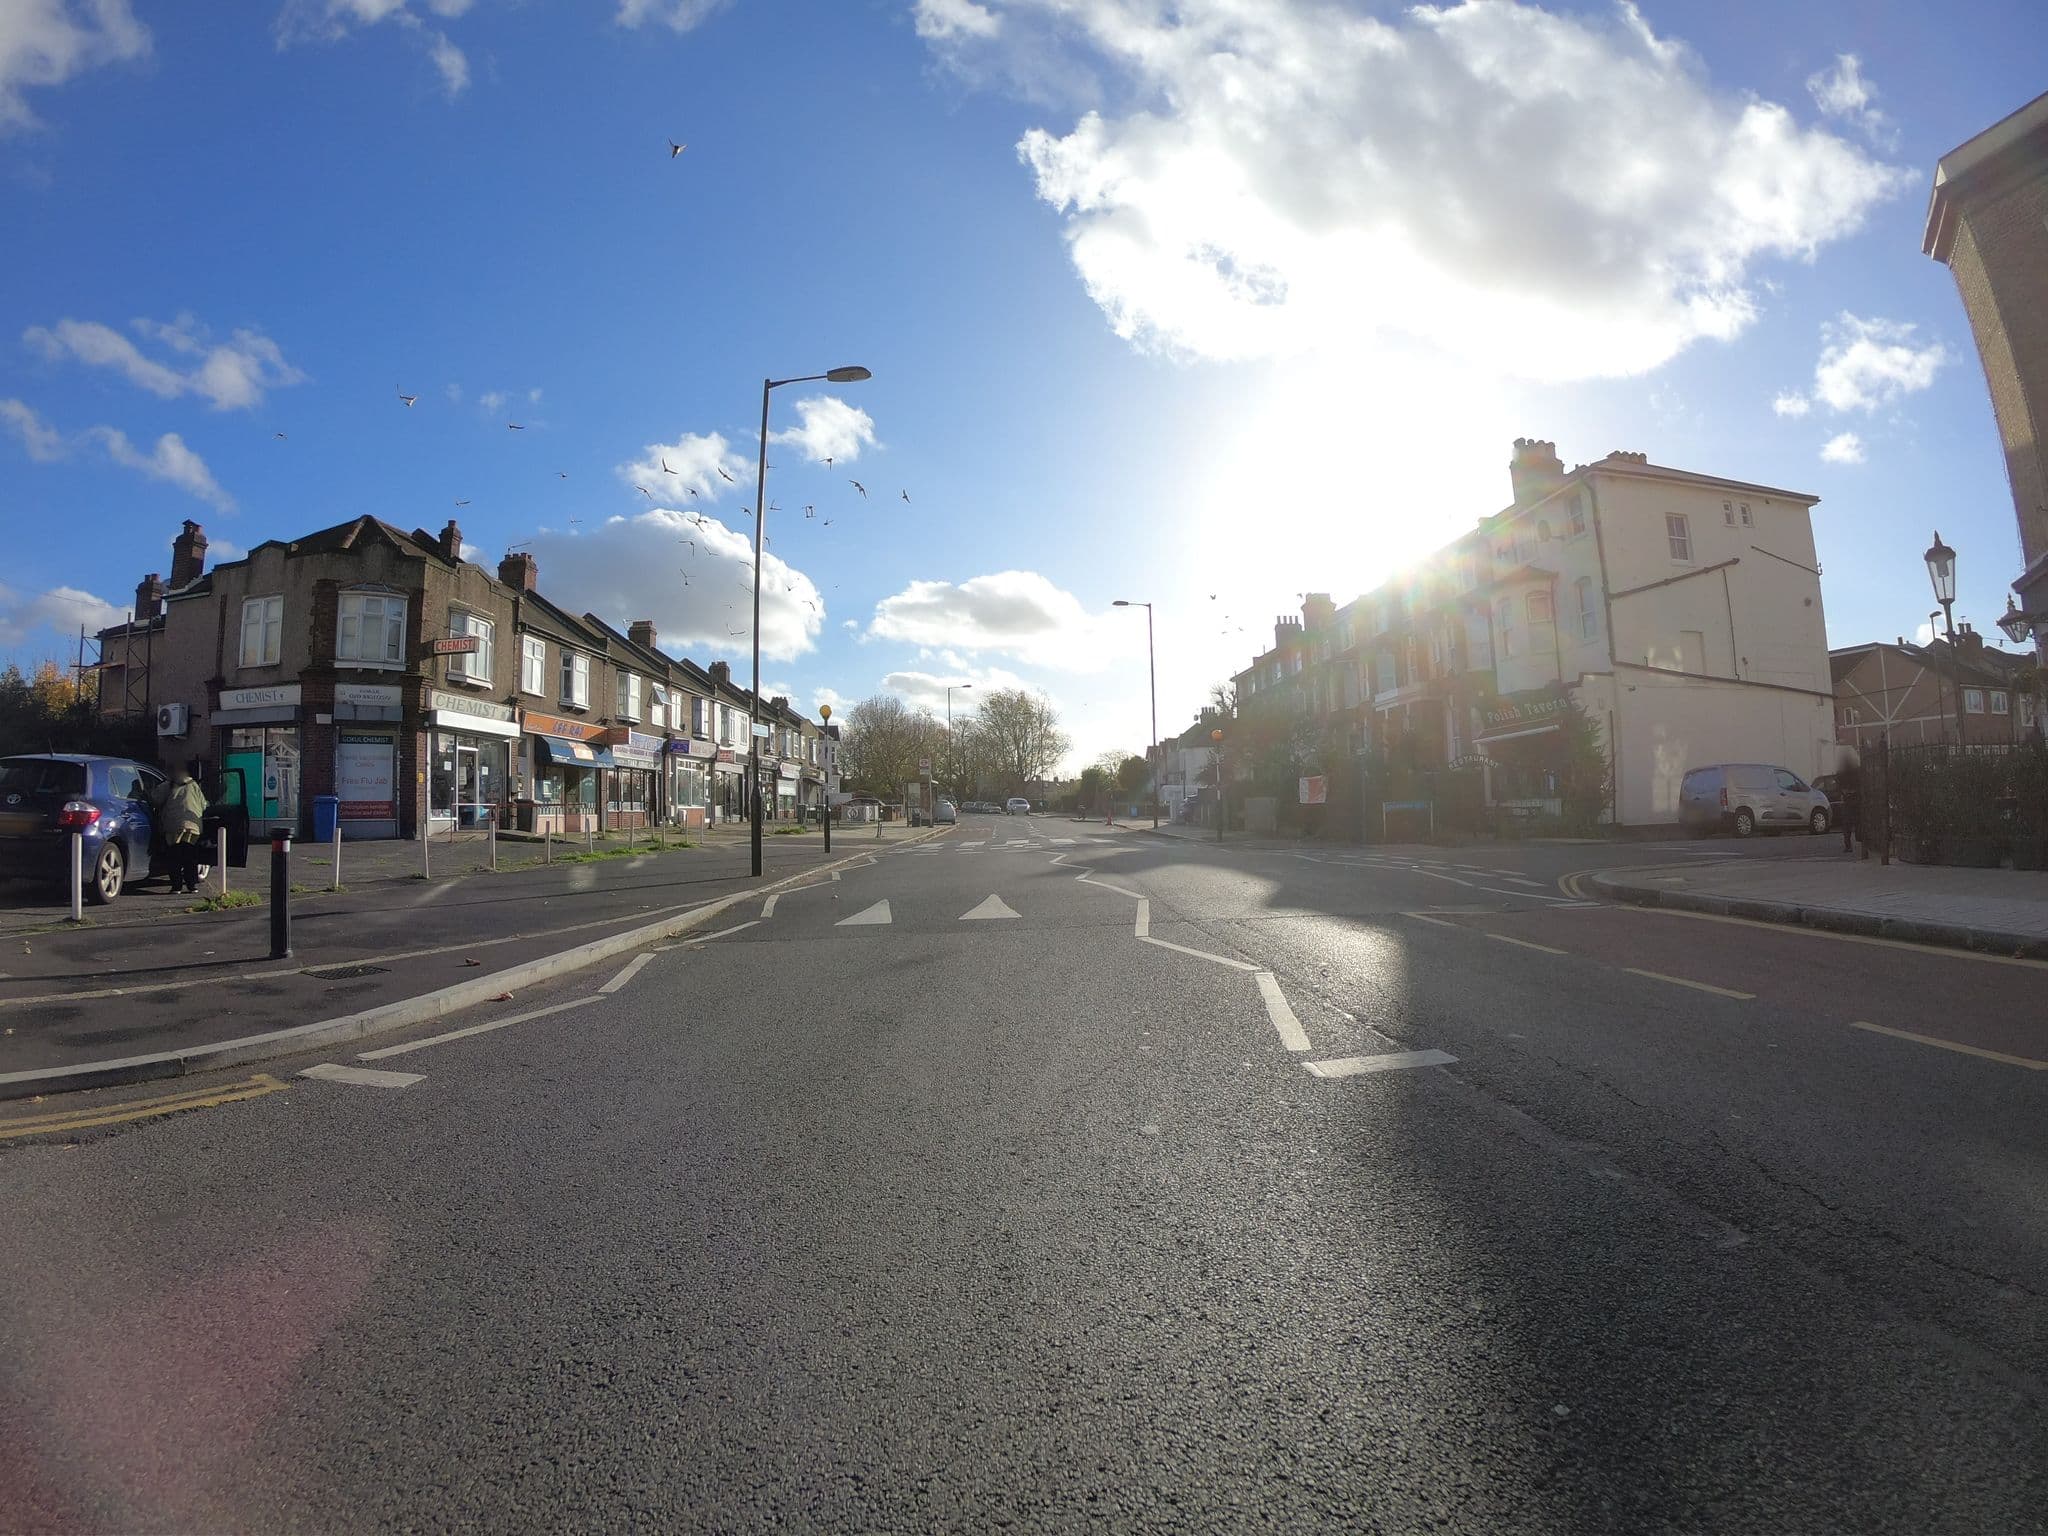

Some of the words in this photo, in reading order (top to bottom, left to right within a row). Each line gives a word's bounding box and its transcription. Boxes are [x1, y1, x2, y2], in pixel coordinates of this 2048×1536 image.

[436, 639, 472, 651] CHEMIST
[235, 690, 276, 704] CHEMIST
[436, 694, 498, 718] CHEMIST
[1487, 705, 1521, 722] Polish
[1524, 697, 1568, 716] Tavern
[1448, 753, 1499, 770] RESTAURANT
